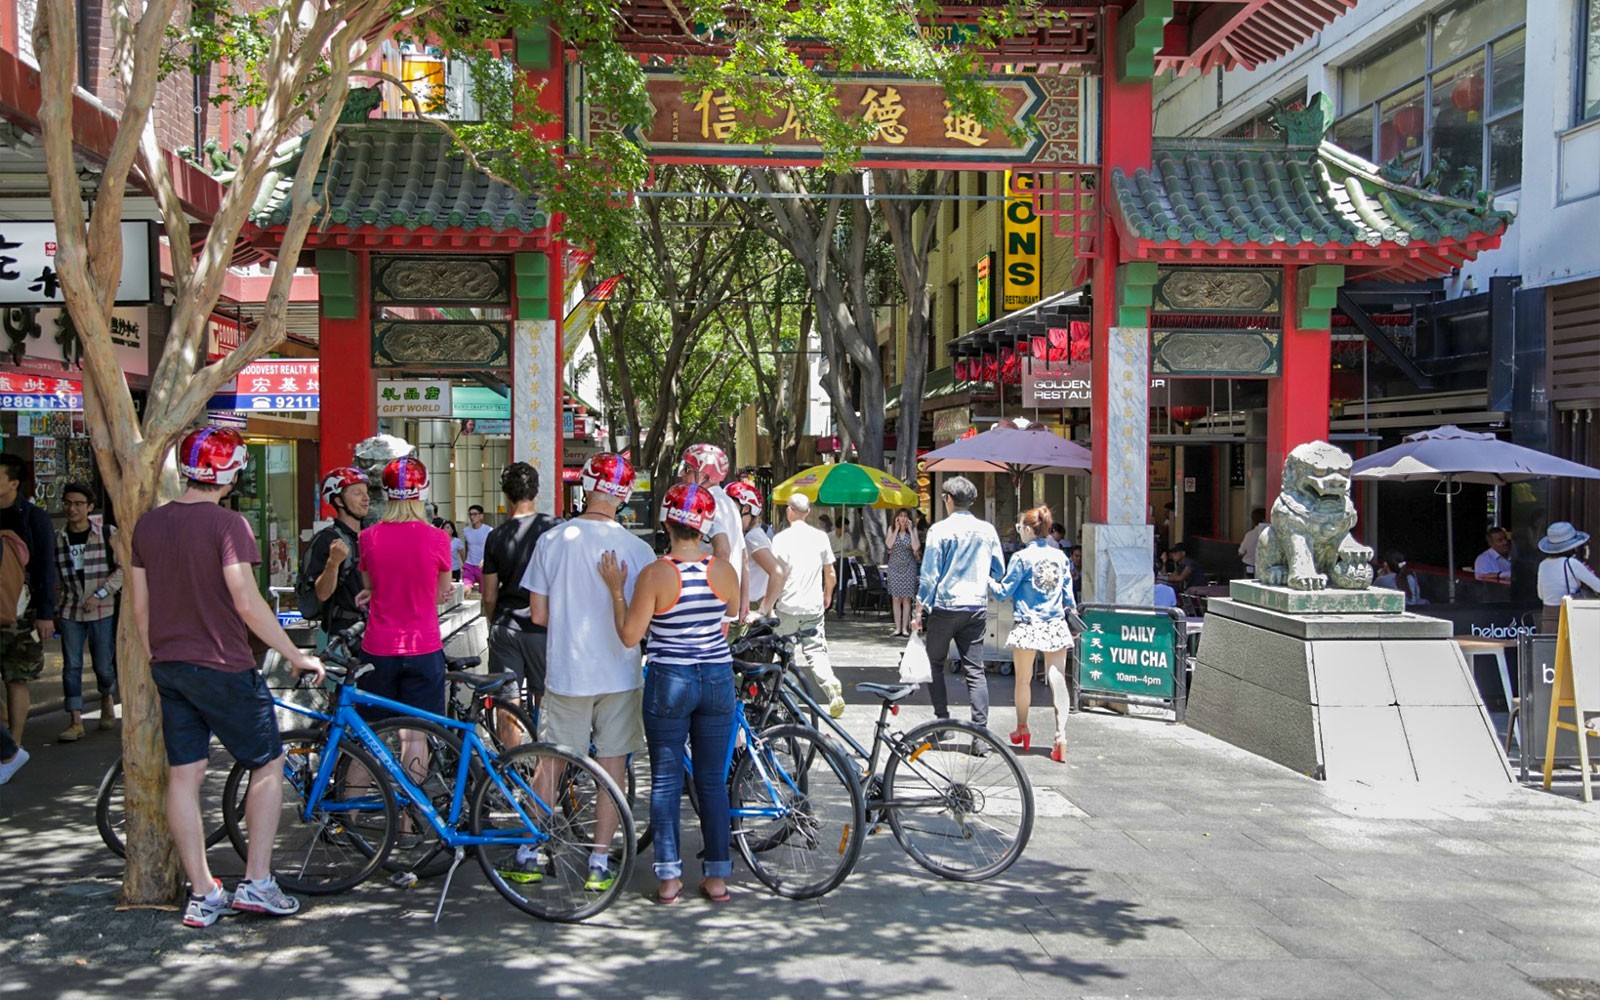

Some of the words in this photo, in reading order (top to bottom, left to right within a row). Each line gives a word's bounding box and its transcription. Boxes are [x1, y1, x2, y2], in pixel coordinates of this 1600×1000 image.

[1005, 295, 1039, 305] RESTAURANT
[240, 365, 279, 375] GOODVEST
[280, 365, 308, 375] REALTY
[1033, 380, 1091, 389] GOLDEN
[382, 386, 440, 400] 礼品店
[1034, 390, 1092, 399] RESTAU
[275, 396, 312, 408] 9211
[383, 404, 405, 413] GIFT
[407, 404, 440, 412] WORLD
[598, 479, 630, 494] BONZA
[669, 506, 701, 521] BONZA
[1121, 625, 1156, 643] DAILY
[1089, 623, 1104, 681] 天天茶市
[1109, 647, 1138, 665] YUM
[1140, 650, 1168, 668] CHA
